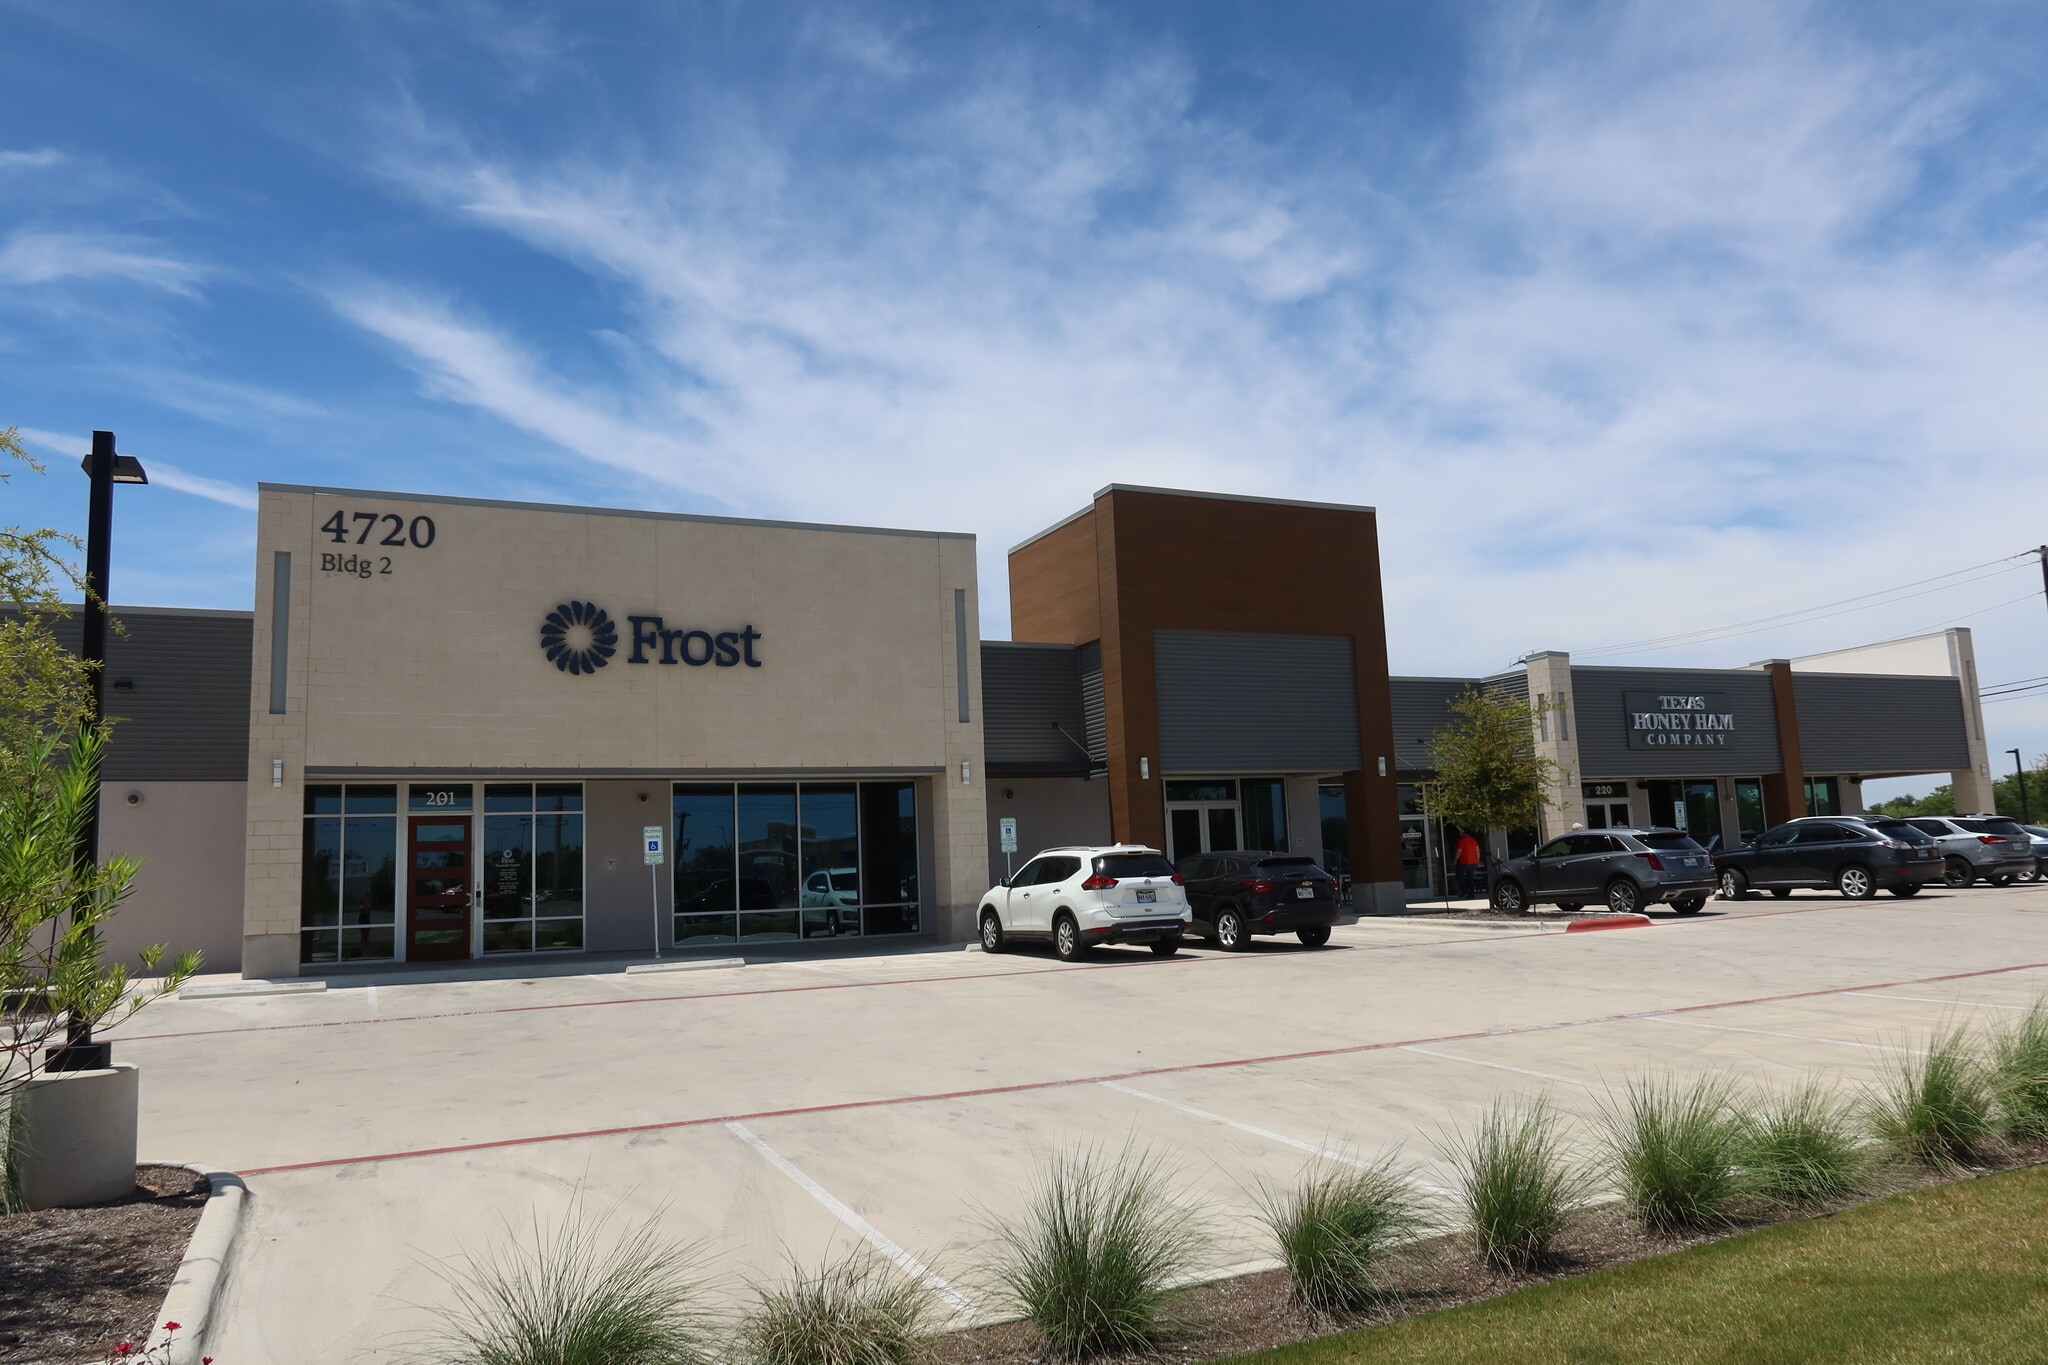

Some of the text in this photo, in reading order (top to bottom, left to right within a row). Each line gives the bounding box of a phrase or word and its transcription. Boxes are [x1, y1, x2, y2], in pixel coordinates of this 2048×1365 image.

[321, 510, 436, 549] 4720
[320, 553, 393, 579] Bldg 2
[627, 615, 762, 668] Frost
[1657, 695, 1705, 710] TEXAS
[1631, 712, 1735, 730] HONEY HAM
[1647, 733, 1725, 745] COMPANY
[1595, 785, 1613, 795] 220
[425, 791, 456, 806] 201
